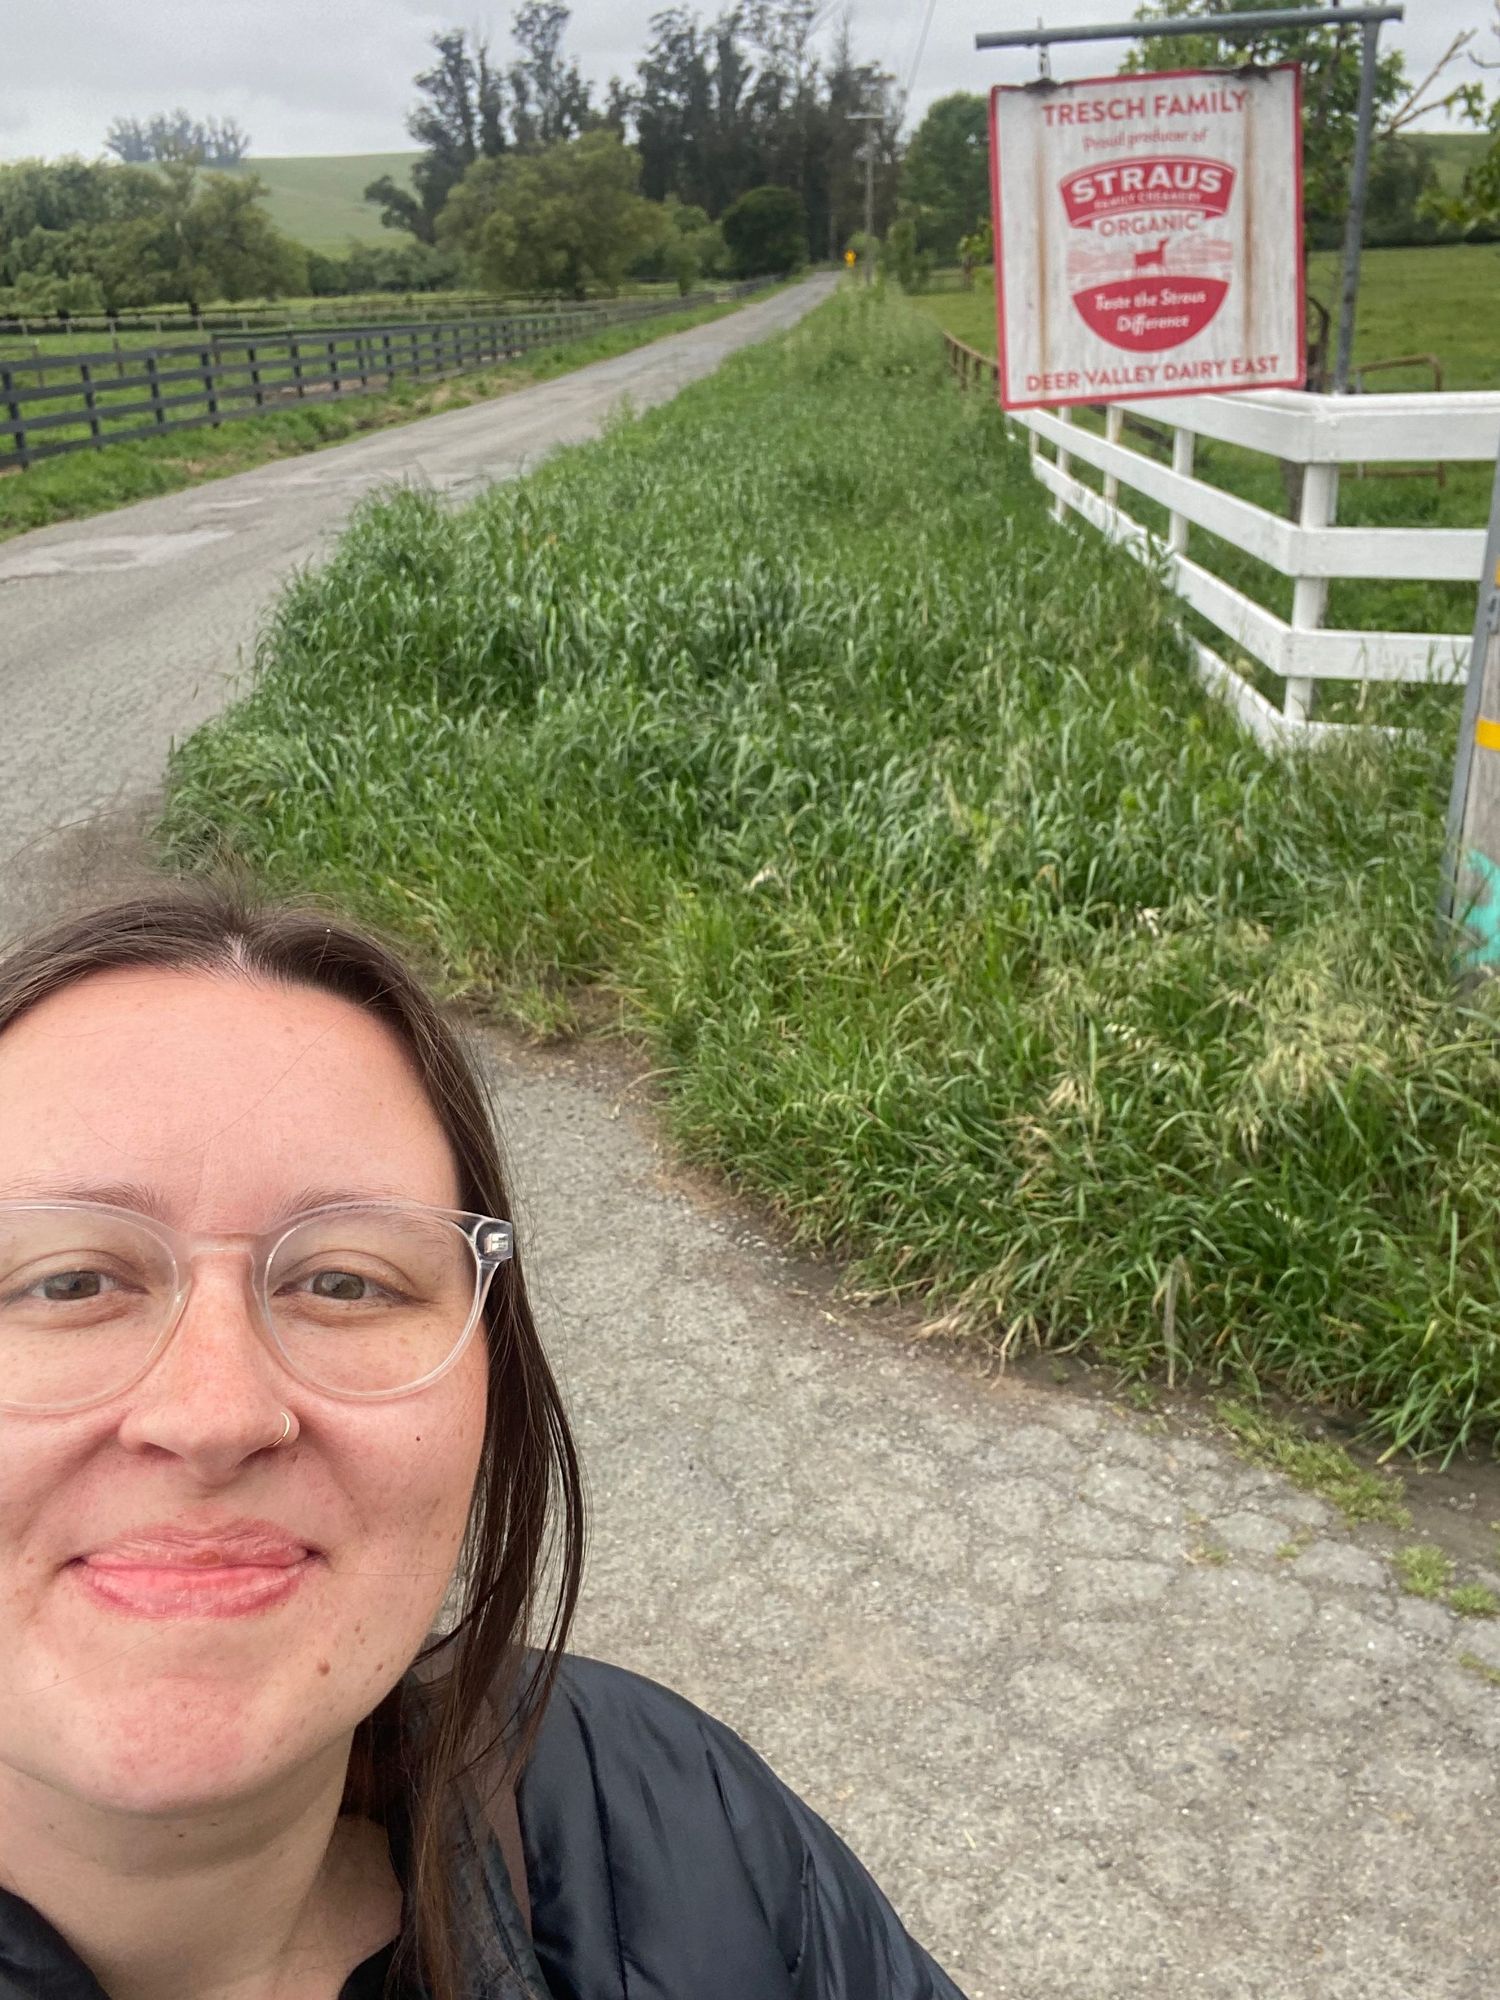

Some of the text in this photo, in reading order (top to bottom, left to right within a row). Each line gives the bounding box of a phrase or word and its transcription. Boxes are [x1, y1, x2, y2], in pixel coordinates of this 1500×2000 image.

[1042, 89, 1248, 127] TRESCH FAMILY
[1128, 129, 1188, 148] producer
[1071, 163, 1223, 205] STRAUS
[1100, 213, 1198, 238] ORGANIC
[1095, 288, 1206, 311] Taste the Straus
[1116, 313, 1190, 336] Difference
[1026, 356, 1279, 391] DEER VALLEY DAIRY EAST
